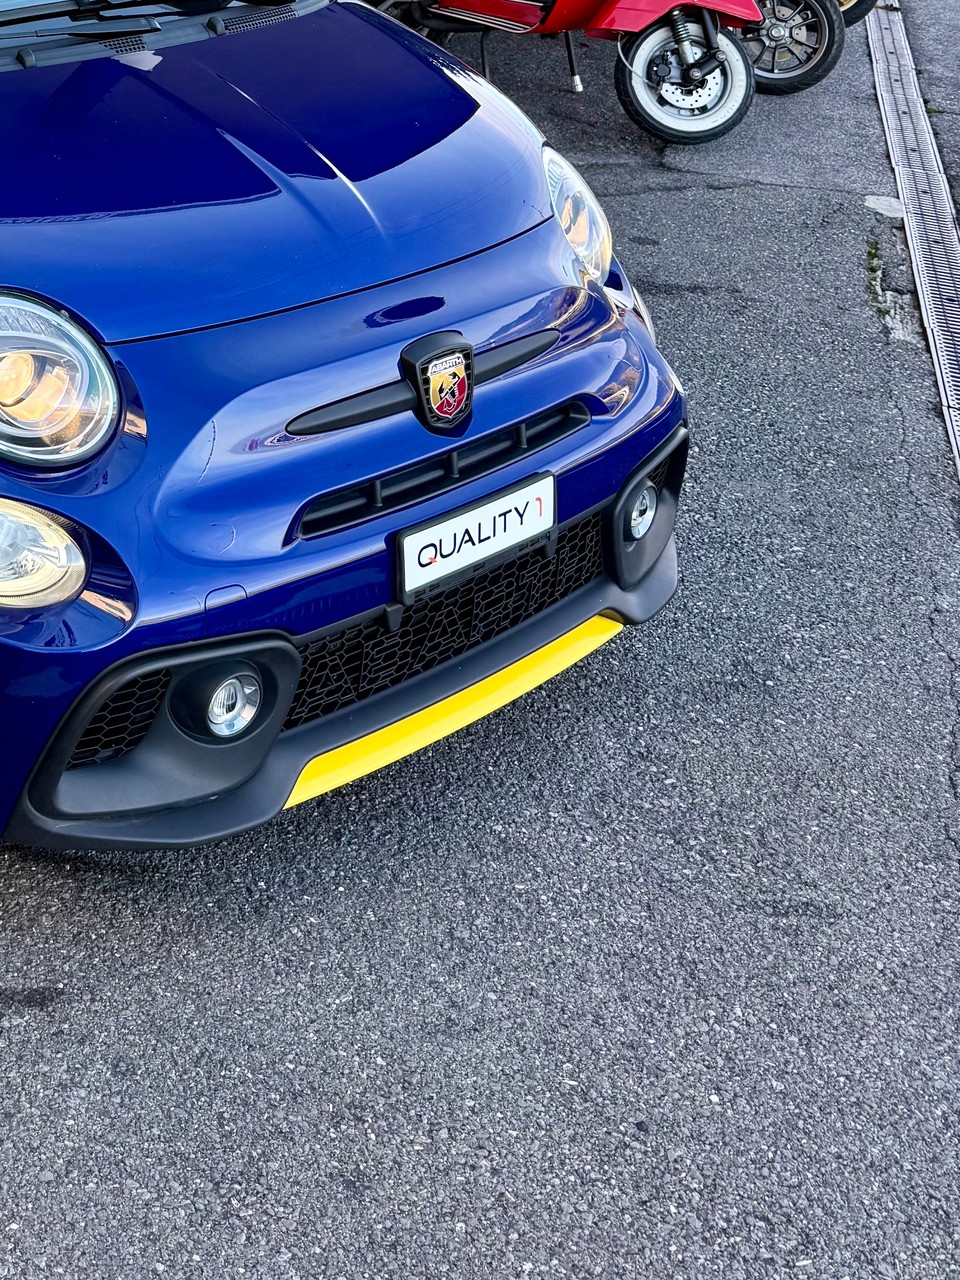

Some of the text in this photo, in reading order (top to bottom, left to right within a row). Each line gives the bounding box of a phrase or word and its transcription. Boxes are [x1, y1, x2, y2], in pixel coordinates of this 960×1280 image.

[431, 356, 462, 372] ABARTH
[417, 496, 543, 568] QUALITY 1
